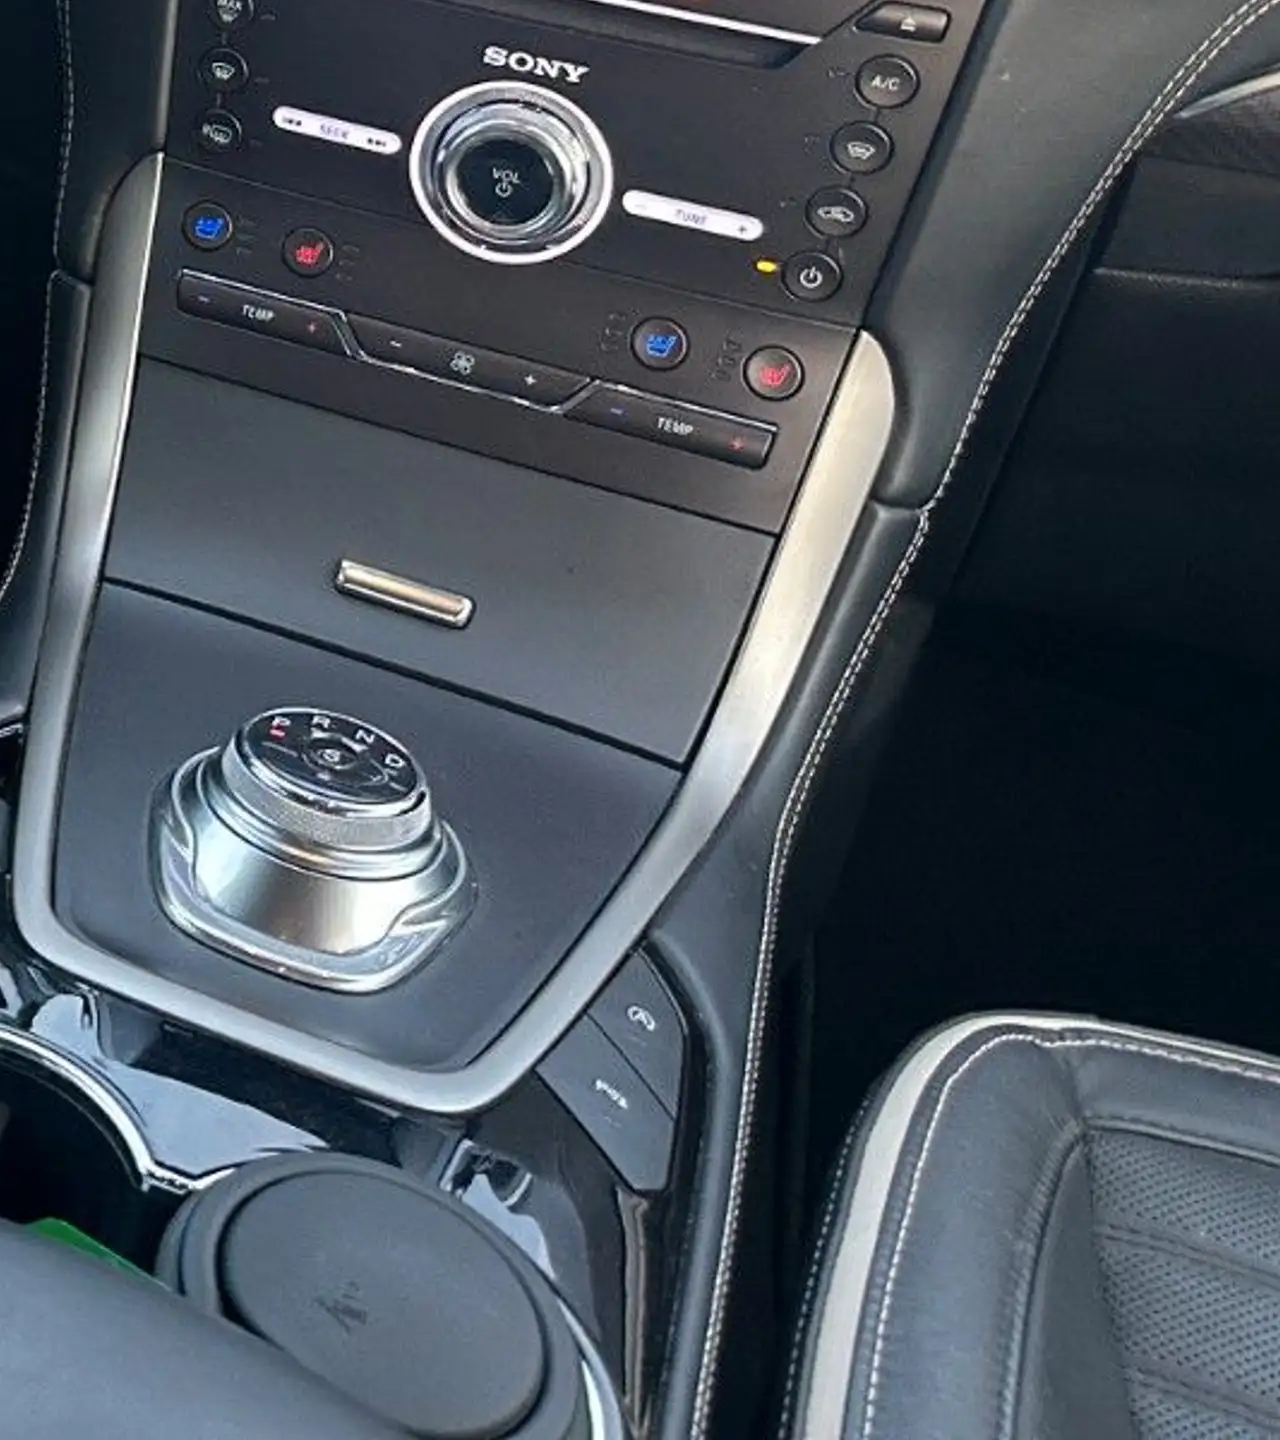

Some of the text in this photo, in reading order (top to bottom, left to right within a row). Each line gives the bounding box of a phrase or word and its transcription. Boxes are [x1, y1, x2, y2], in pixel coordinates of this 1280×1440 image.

[482, 45, 591, 84] SONY
[870, 74, 901, 93] A/C
[242, 303, 276, 322] TEMP
[657, 415, 693, 436] TEMP
[384, 753, 404, 769] D
